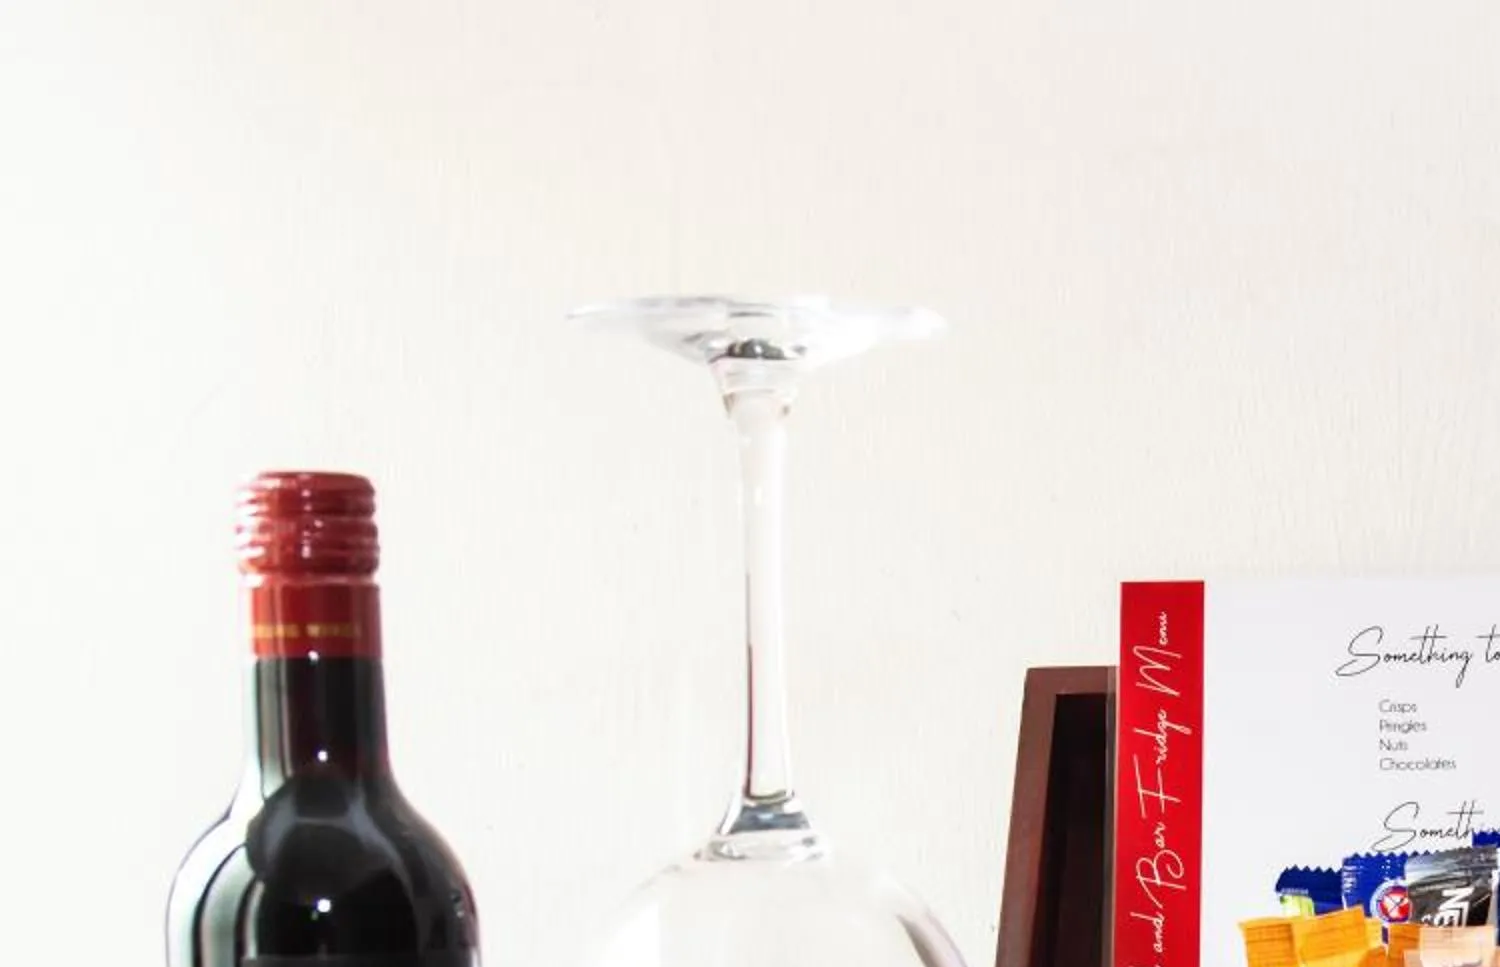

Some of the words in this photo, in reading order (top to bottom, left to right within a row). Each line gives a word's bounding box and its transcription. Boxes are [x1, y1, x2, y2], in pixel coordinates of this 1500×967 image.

[1133, 612, 1182, 696] Menu
[1335, 624, 1472, 688] Something
[1133, 709, 1192, 818] Fridge
[1379, 739, 1408, 752] Nuts
[1379, 757, 1457, 771] Chocolates
[1136, 822, 1187, 908] Bar
[1130, 911, 1165, 952] and
